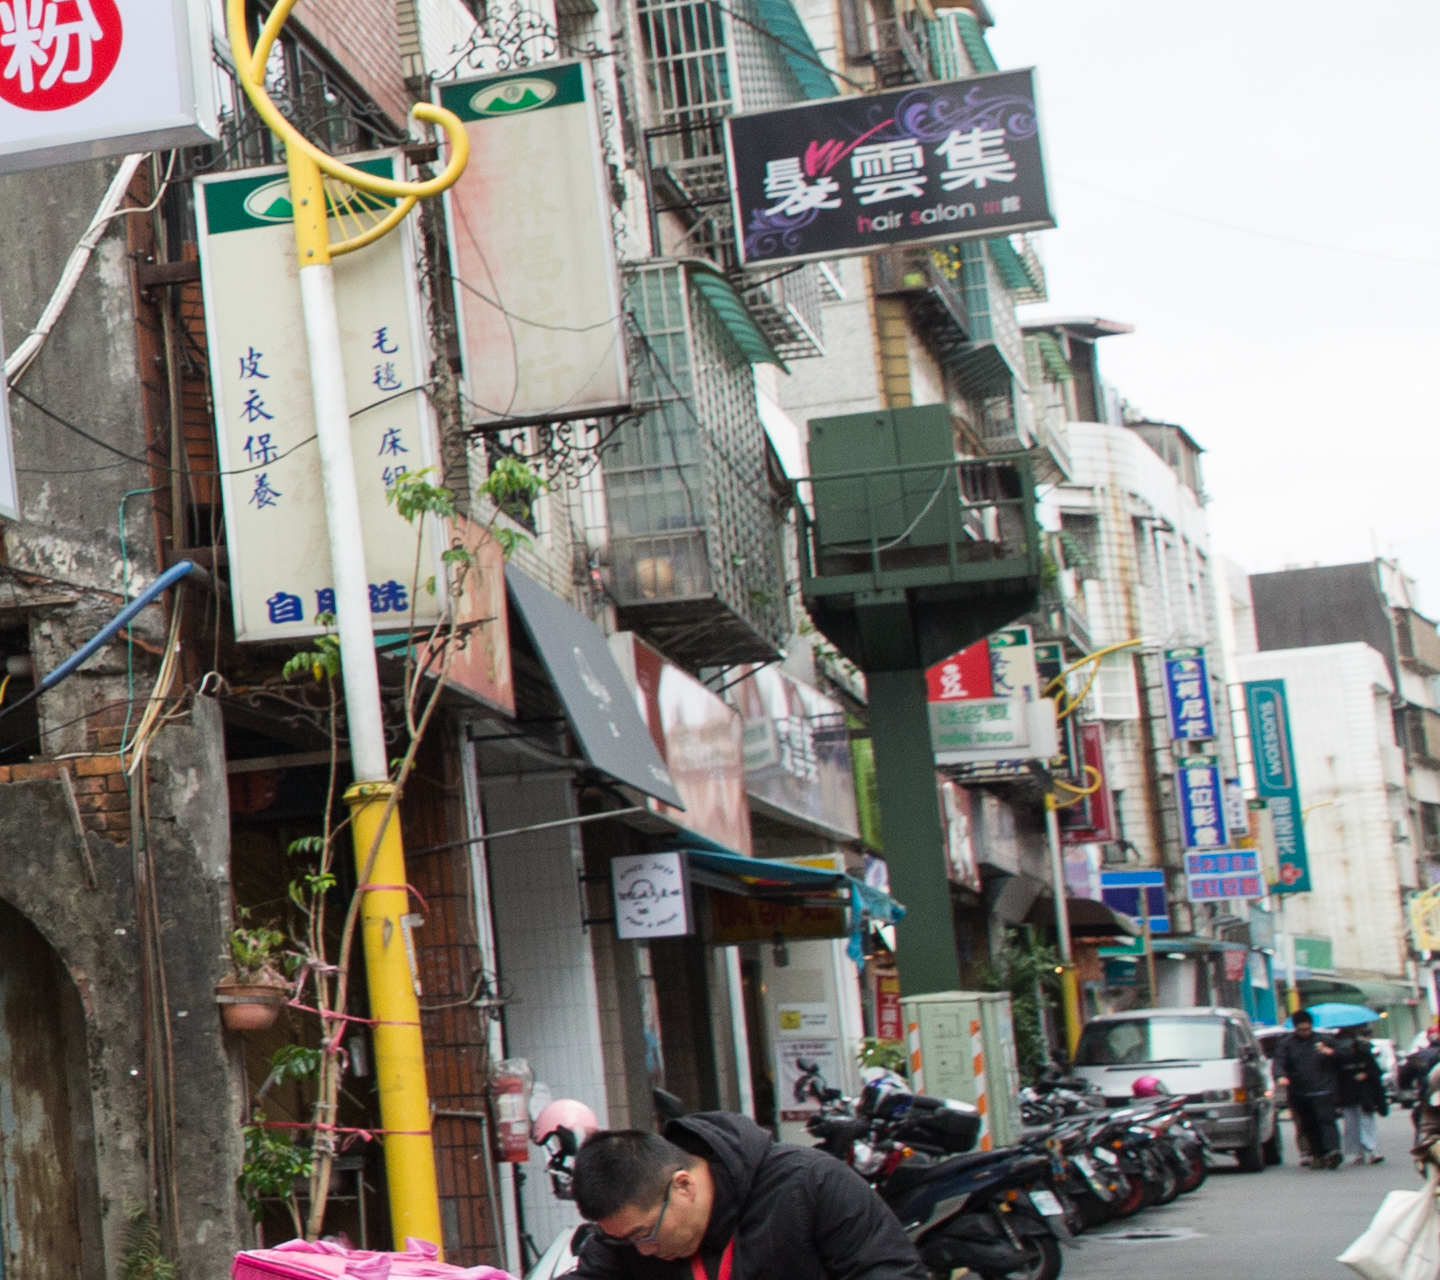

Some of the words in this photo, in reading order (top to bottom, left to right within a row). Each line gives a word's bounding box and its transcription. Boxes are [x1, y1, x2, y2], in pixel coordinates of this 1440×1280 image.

[763, 128, 1018, 217] 髮雲集
[857, 209, 903, 234] hair
[909, 202, 976, 226] salon
[237, 346, 283, 510] 皮衣保養
[1258, 701, 1283, 777] watsons
